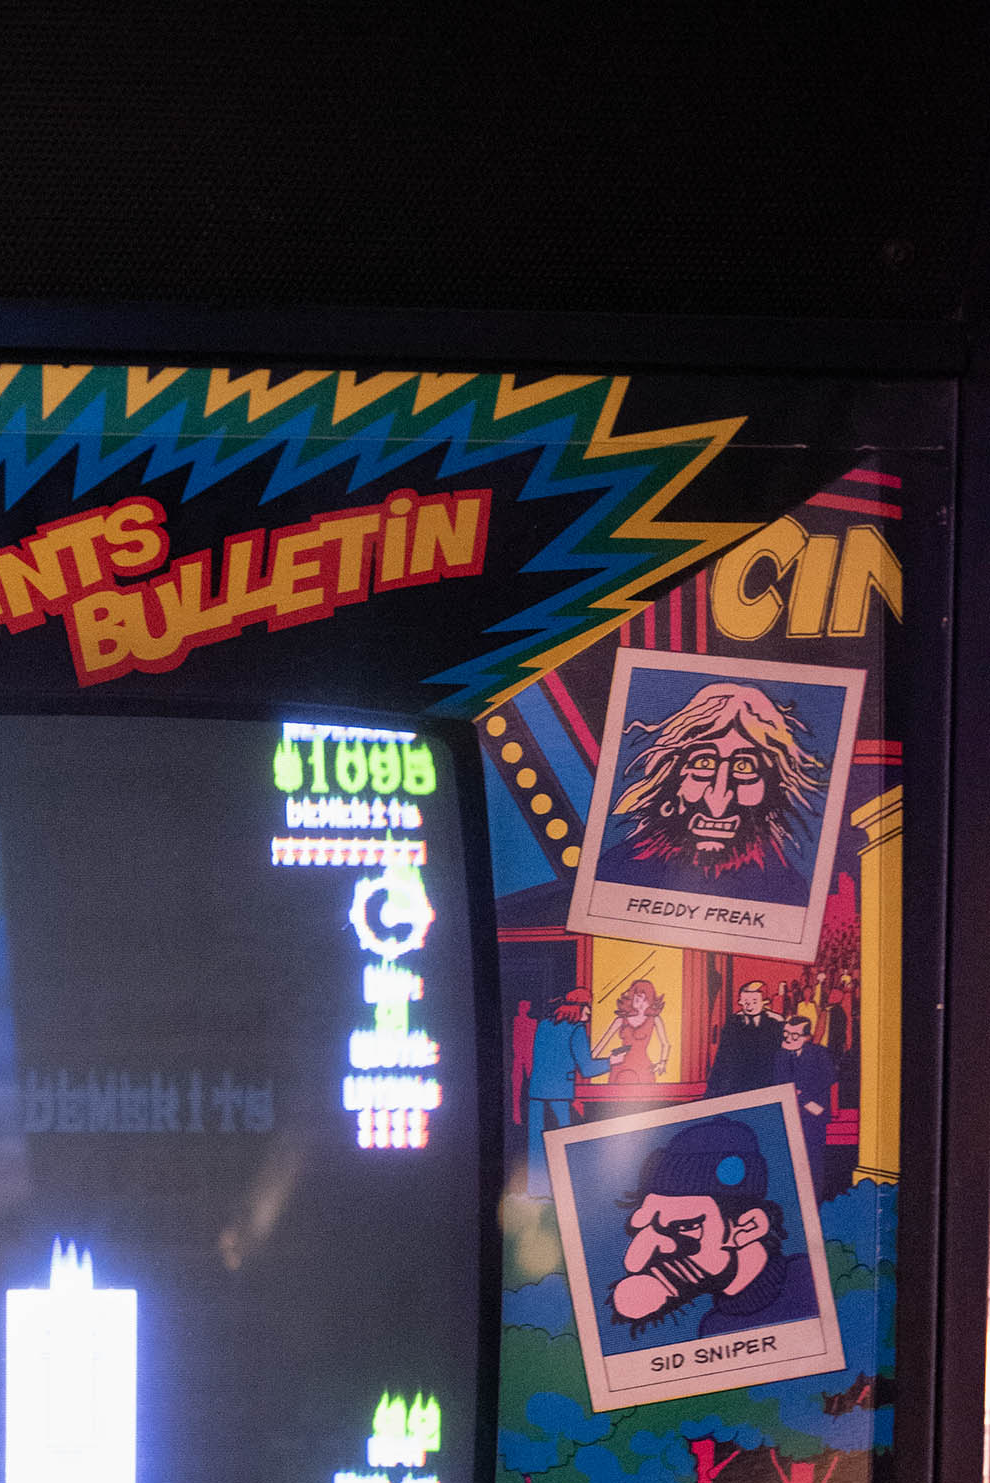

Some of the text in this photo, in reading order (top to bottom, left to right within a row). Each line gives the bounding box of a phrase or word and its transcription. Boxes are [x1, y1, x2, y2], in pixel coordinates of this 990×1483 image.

[626, 898, 765, 928] FREDDY FREAK
[651, 1336, 777, 1372] SID SNIPER
